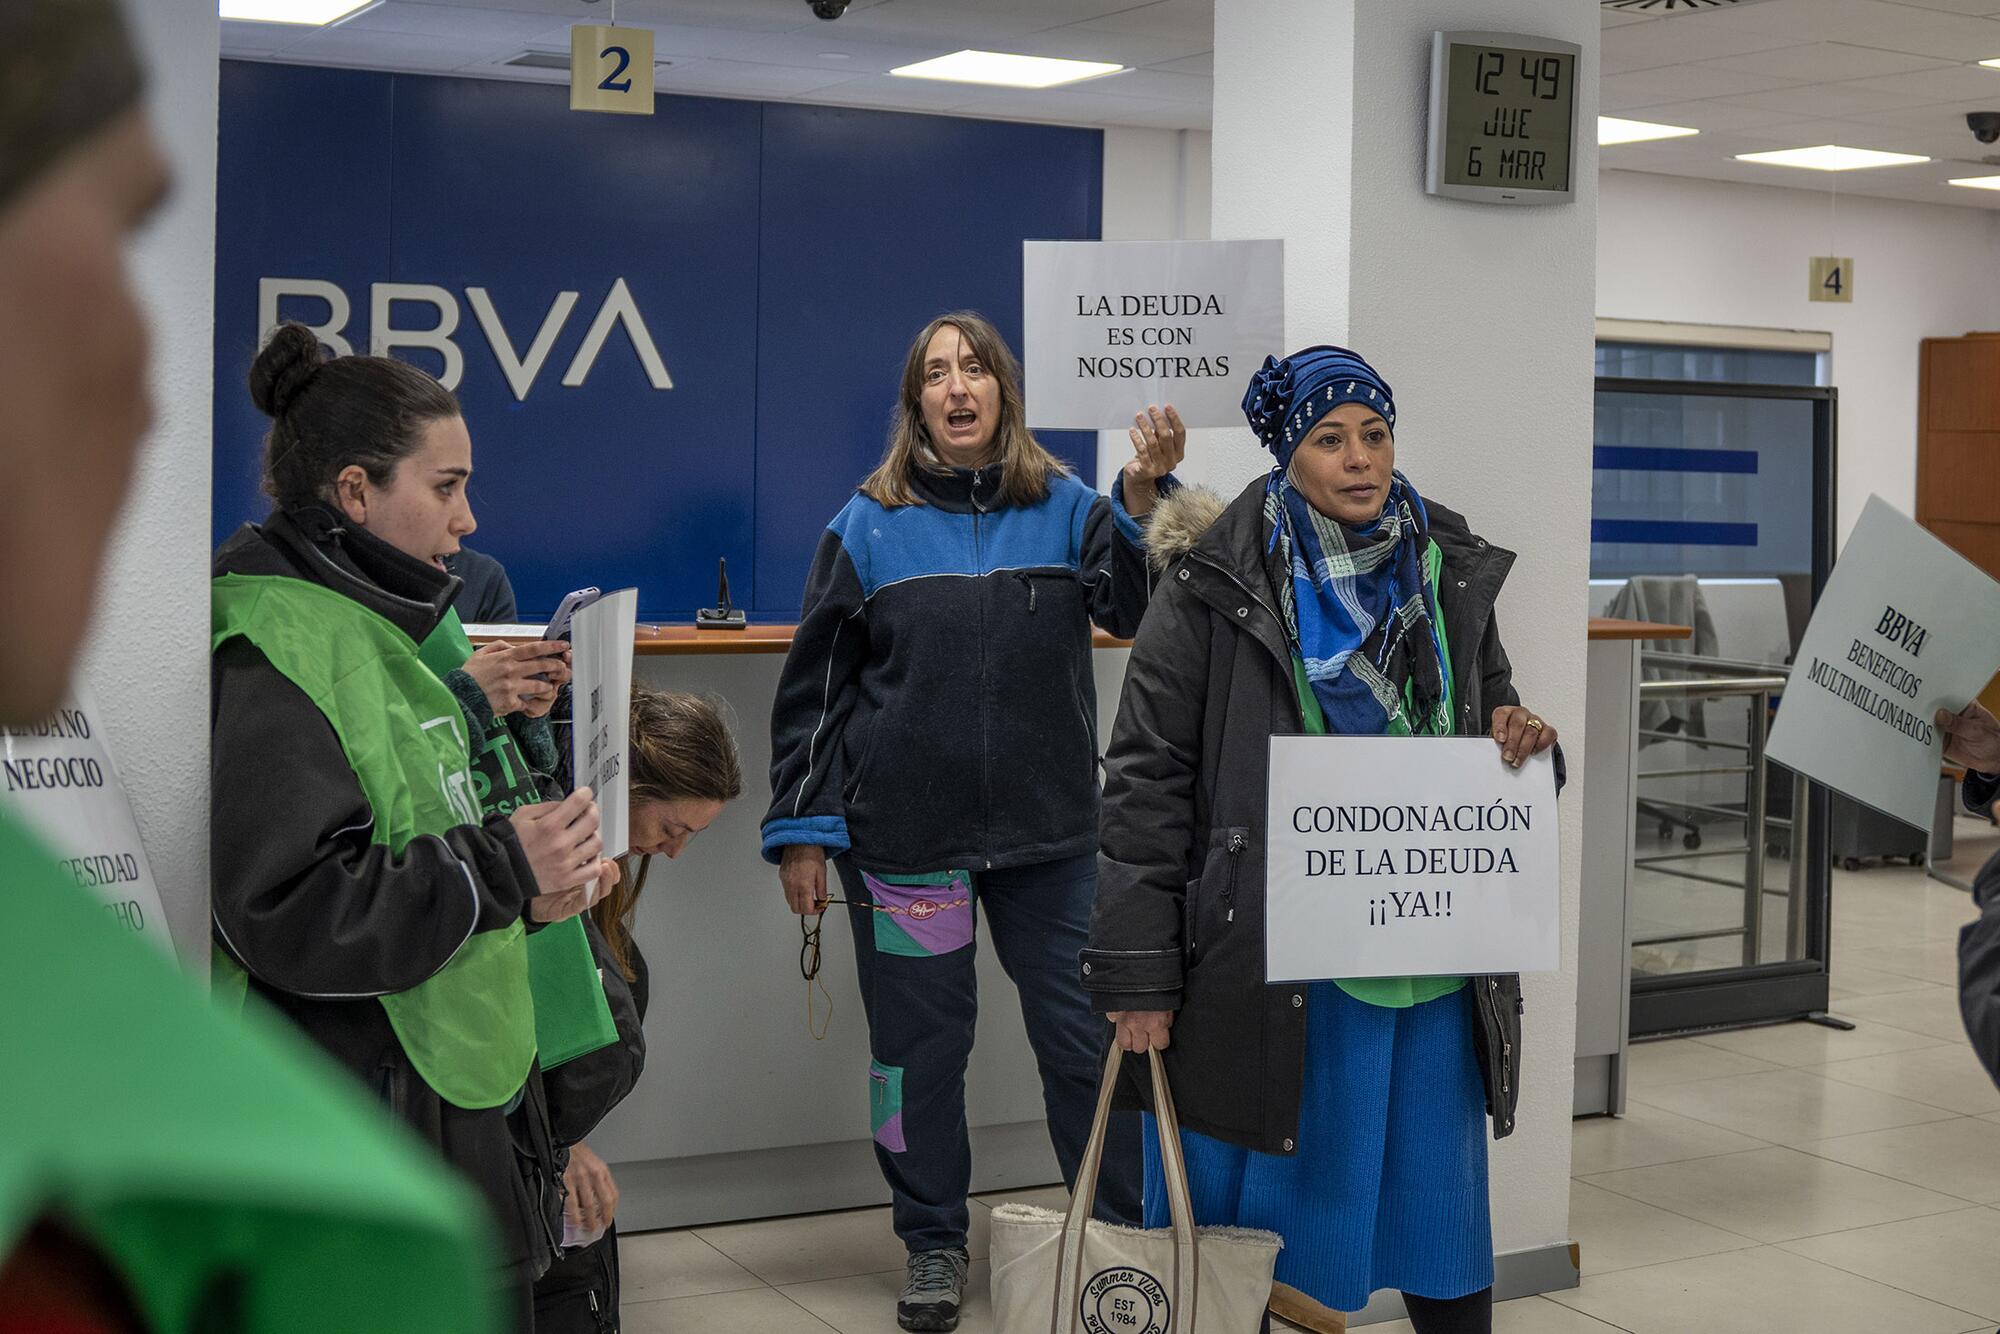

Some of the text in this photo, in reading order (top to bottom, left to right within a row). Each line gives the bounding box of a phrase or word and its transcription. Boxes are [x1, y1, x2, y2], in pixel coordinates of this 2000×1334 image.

[598, 46, 632, 93] 2
[1475, 53, 1560, 100] 12 49
[1484, 107, 1532, 139] JUE
[1468, 146, 1545, 180] 6 MAR
[1824, 266, 1843, 296] 4
[1077, 294, 1224, 316] LA DEUDA
[1107, 327, 1192, 345] ES CON
[1077, 356, 1230, 378] NOSOTRAS
[1874, 605, 1927, 657] BBVA
[1847, 639, 1922, 699] BENEFICIOS
[1807, 657, 1933, 746] MULTIMILLONARIOS
[61, 709, 90, 740] NO
[2, 757, 104, 792] NEGOCIO
[1293, 798, 1532, 833] CONDONACIÓN
[1305, 848, 1519, 876] DE LA DEUDA
[1370, 891, 1452, 926] ¡¡YA!!
[1090, 1272, 1164, 1307] Summer Vibes
[1114, 1298, 1135, 1312] EST
[1111, 1311, 1136, 1326] 1984
